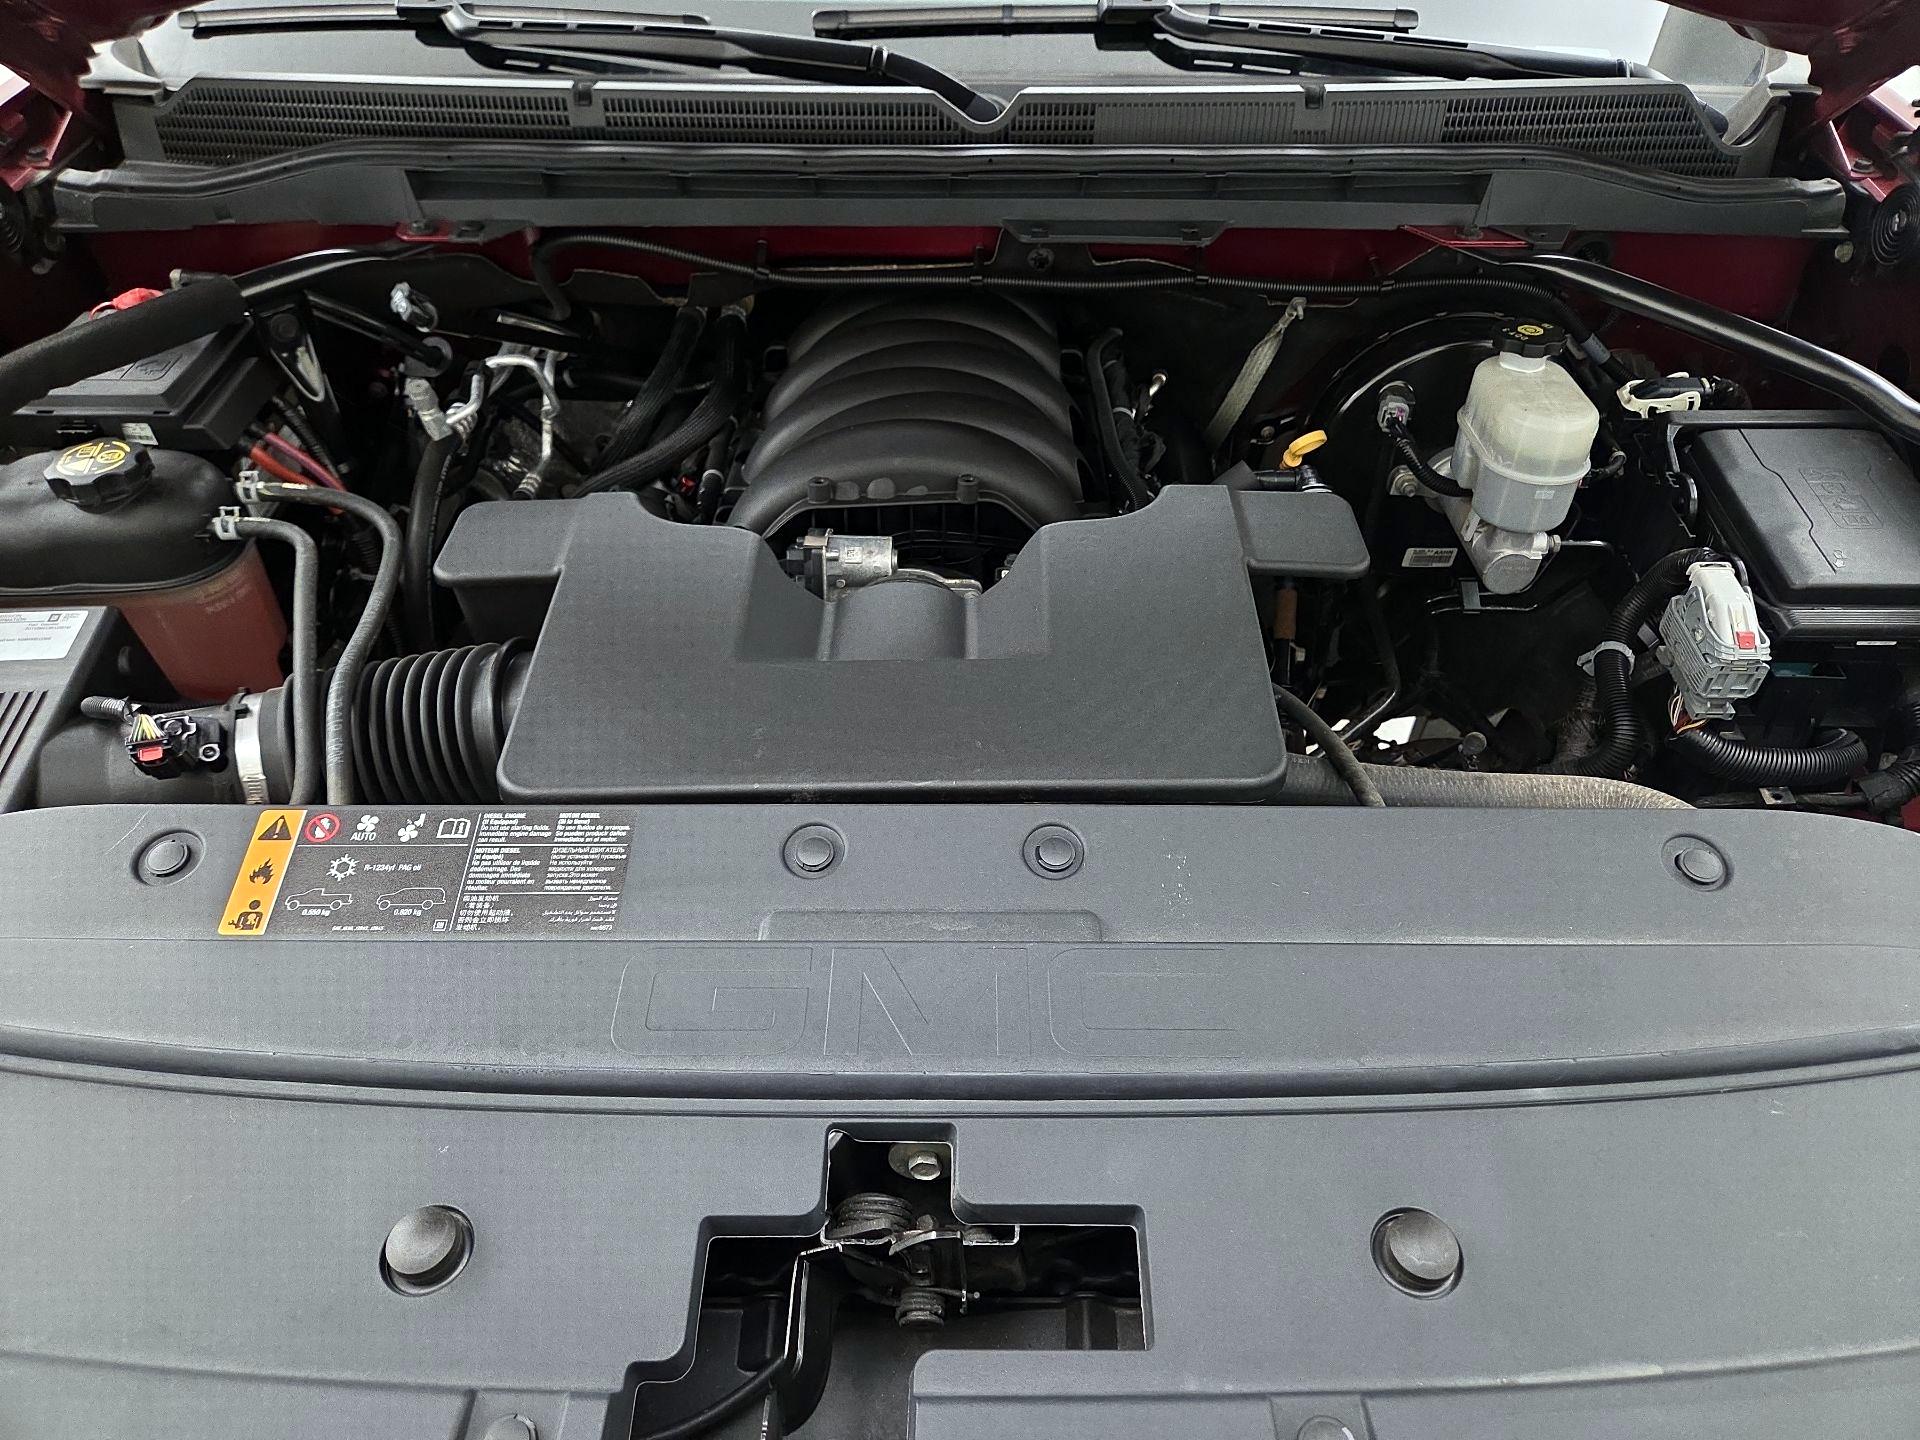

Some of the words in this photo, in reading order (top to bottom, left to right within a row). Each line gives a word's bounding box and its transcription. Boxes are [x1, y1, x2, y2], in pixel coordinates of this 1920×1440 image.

[350, 832, 377, 841] AUTO
[364, 864, 396, 872] R-1234yf
[320, 908, 331, 917] kg
[412, 908, 422, 917] kg
[610, 946, 1238, 1056] GMC
